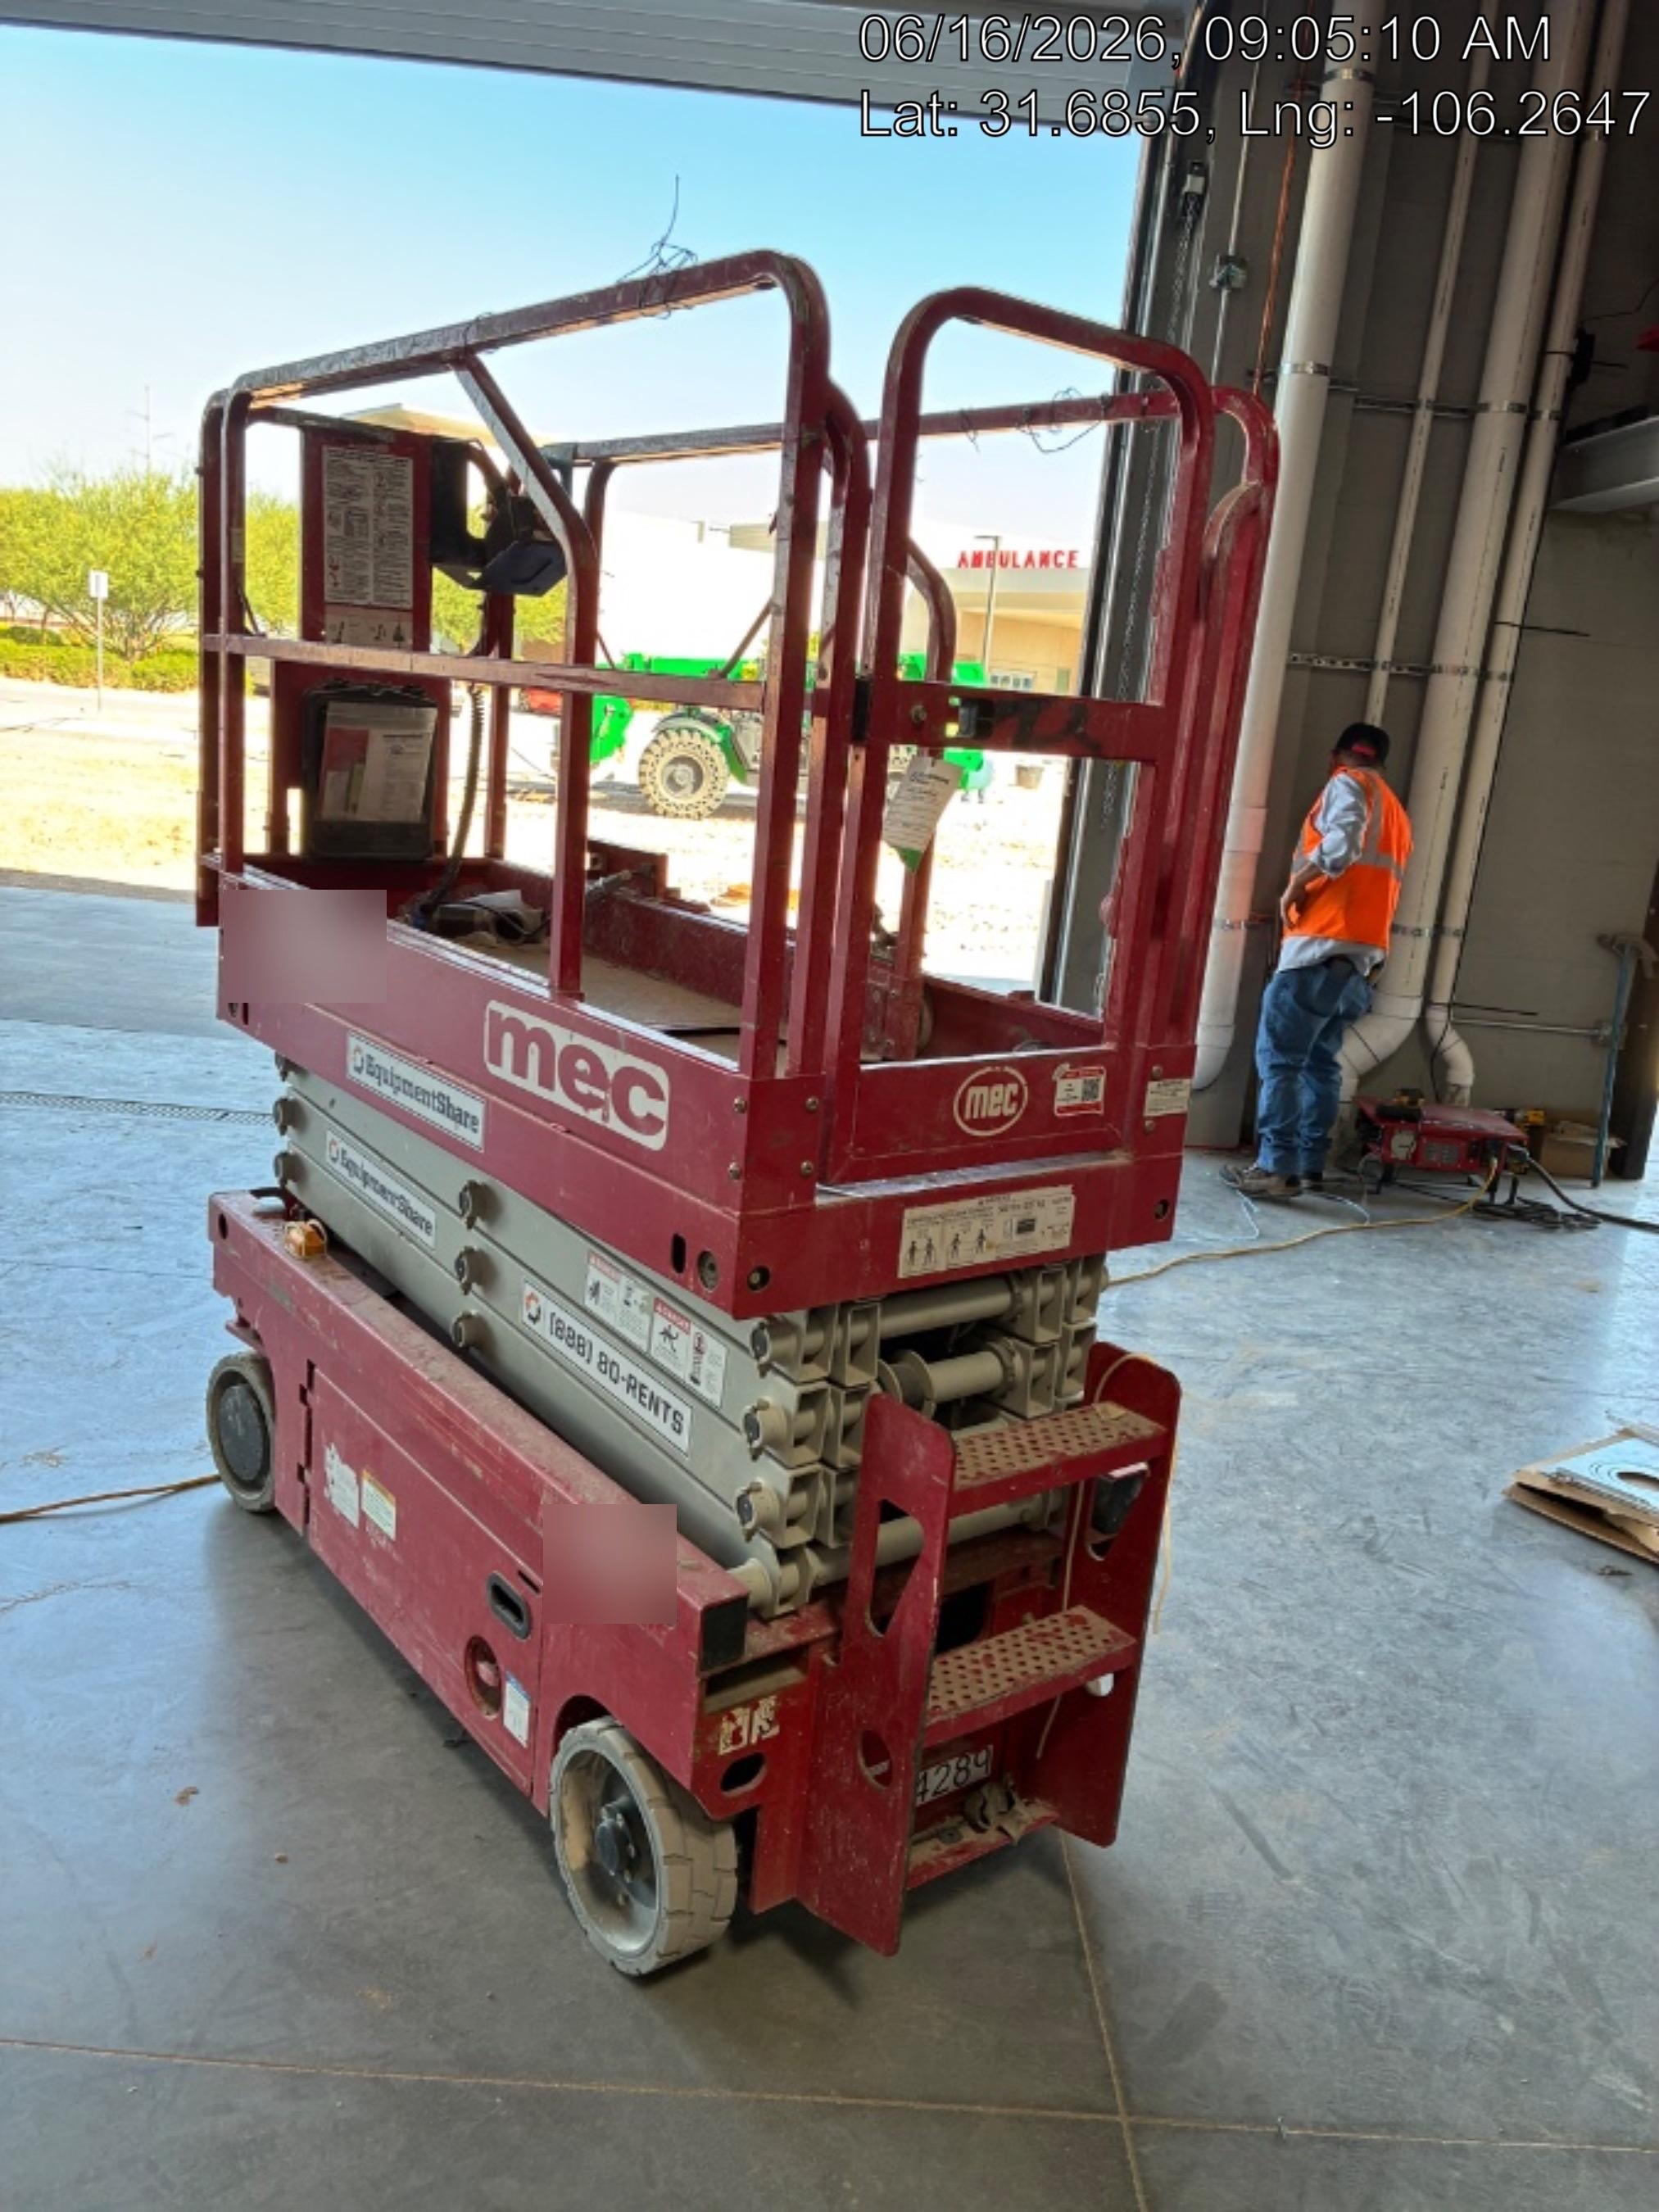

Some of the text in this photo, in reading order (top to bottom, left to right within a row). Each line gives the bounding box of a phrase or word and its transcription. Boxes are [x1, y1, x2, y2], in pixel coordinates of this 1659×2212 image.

[958, 550, 1079, 569] AMBULANCE
[365, 1053, 480, 1134] EquipmentShare
[340, 1149, 434, 1237] EquipmentShare
[550, 1312, 593, 1363] (888)
[596, 1351, 685, 1435] 80-RENTS
